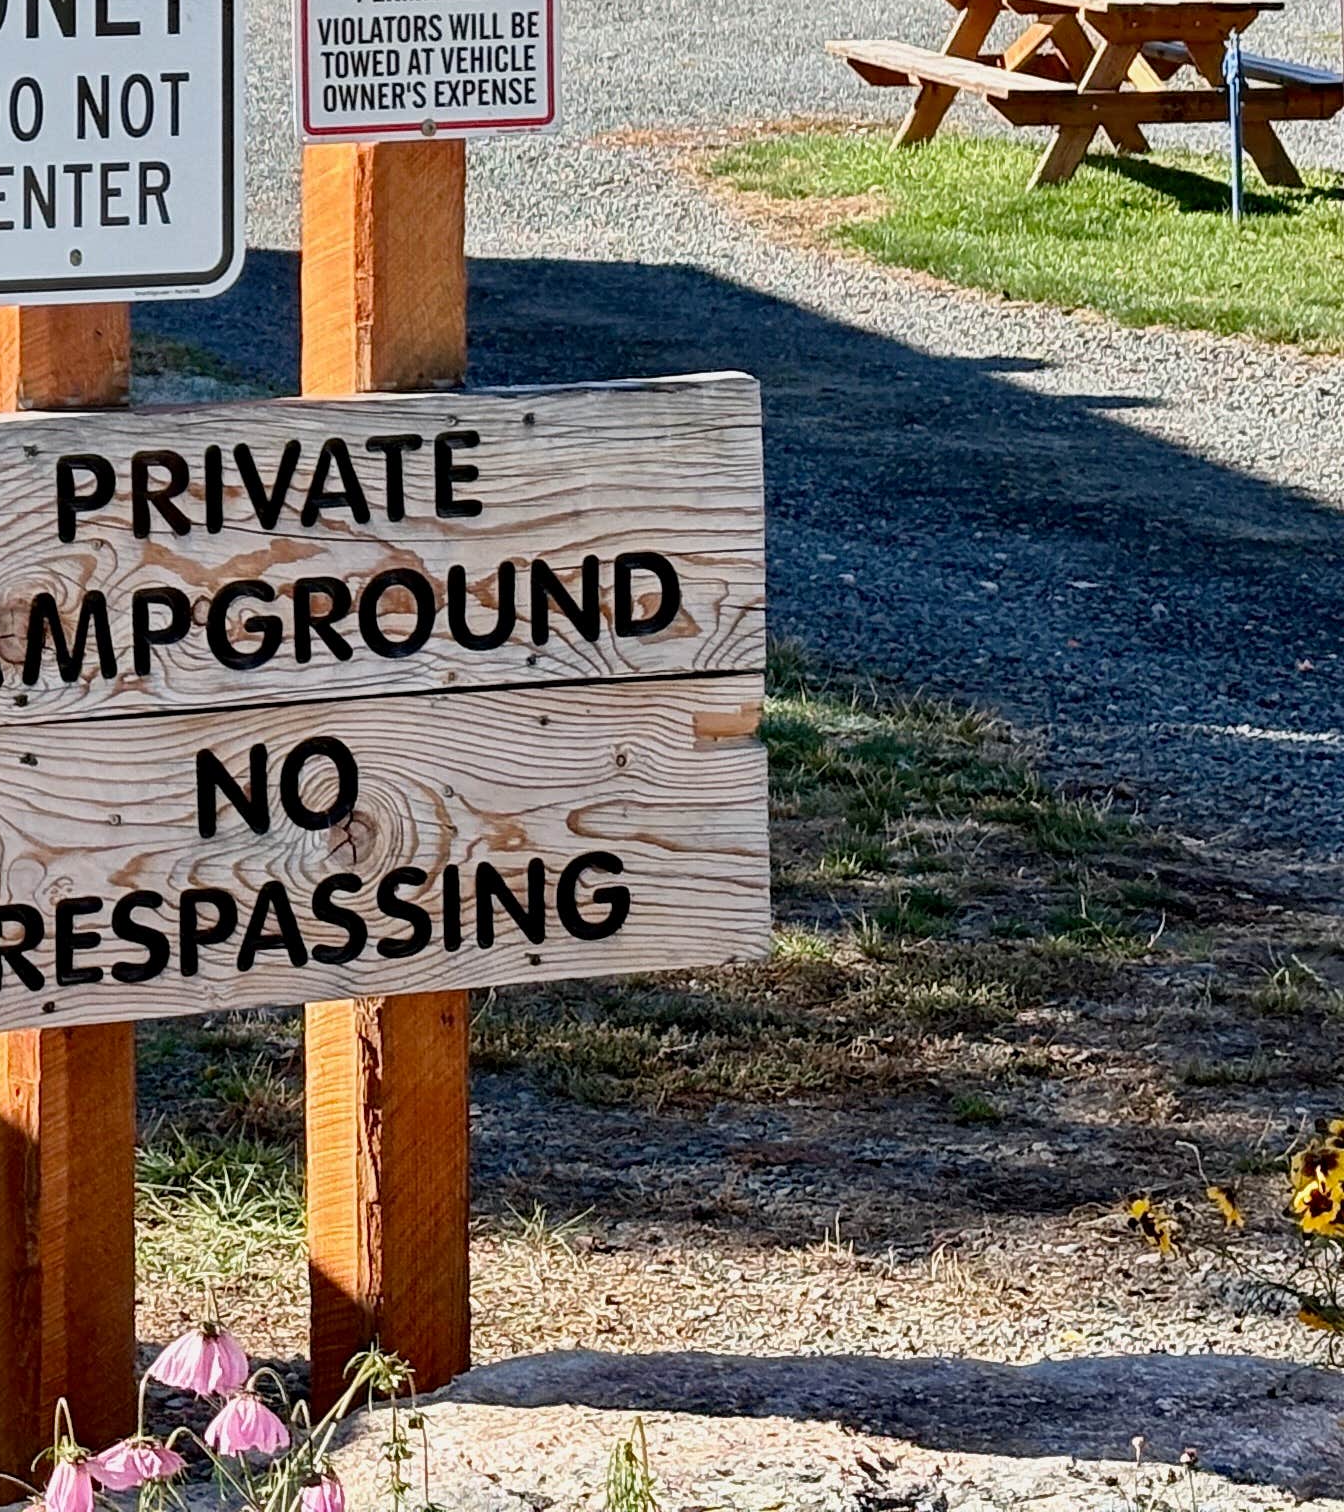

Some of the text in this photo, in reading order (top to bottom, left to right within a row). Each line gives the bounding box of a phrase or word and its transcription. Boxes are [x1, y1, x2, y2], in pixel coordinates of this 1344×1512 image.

[318, 11, 539, 45] VIOLATORS WILL BE
[321, 45, 536, 79] TOWED AT VEHICLE
[77, 72, 190, 139] NOT
[323, 78, 536, 112] OWNER'S EXPENSE
[56, 430, 484, 544] PRIVATE
[196, 736, 359, 838] NO
